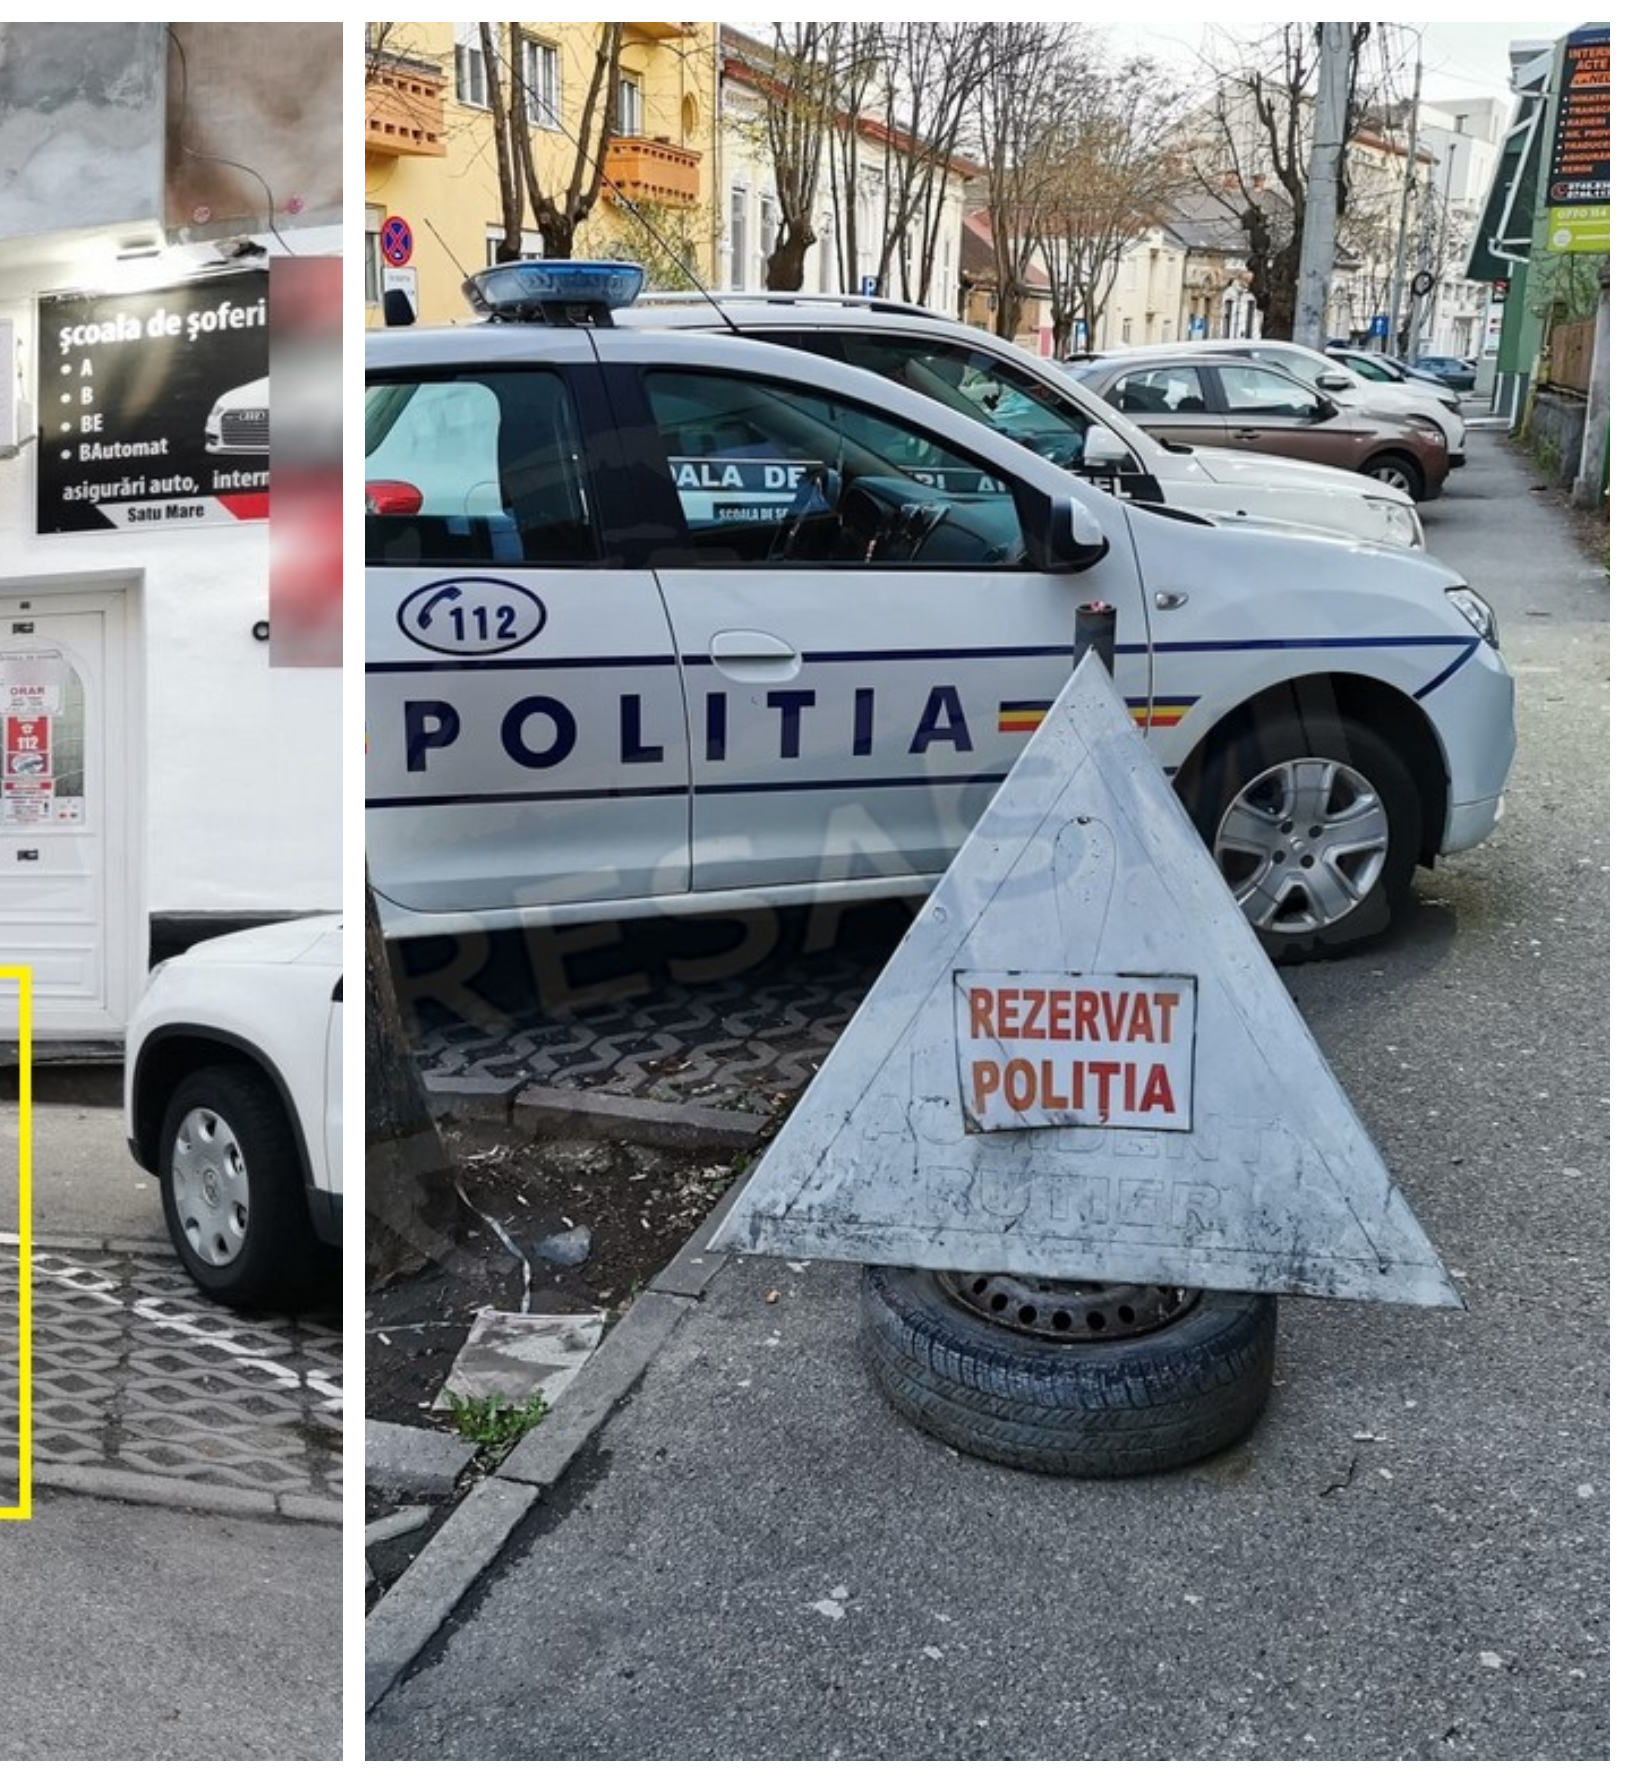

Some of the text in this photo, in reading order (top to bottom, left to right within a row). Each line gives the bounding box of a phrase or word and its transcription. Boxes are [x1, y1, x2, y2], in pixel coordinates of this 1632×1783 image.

[1576, 60, 1608, 71] ACTE
[147, 308, 182, 339] de
[80, 359, 93, 376] A
[80, 387, 93, 405] B
[80, 414, 103, 433] BE
[79, 438, 168, 461] BAutomat
[670, 463, 744, 488] ALA
[62, 476, 146, 503] asigurări
[148, 477, 199, 496] auto,
[127, 504, 205, 523] Satu Mare
[449, 605, 518, 641] 112
[404, 685, 974, 772] POLITIA
[17, 736, 39, 751] 112
[970, 987, 1180, 1043] REZERVAT
[972, 1057, 1176, 1123] POLIȚIA
